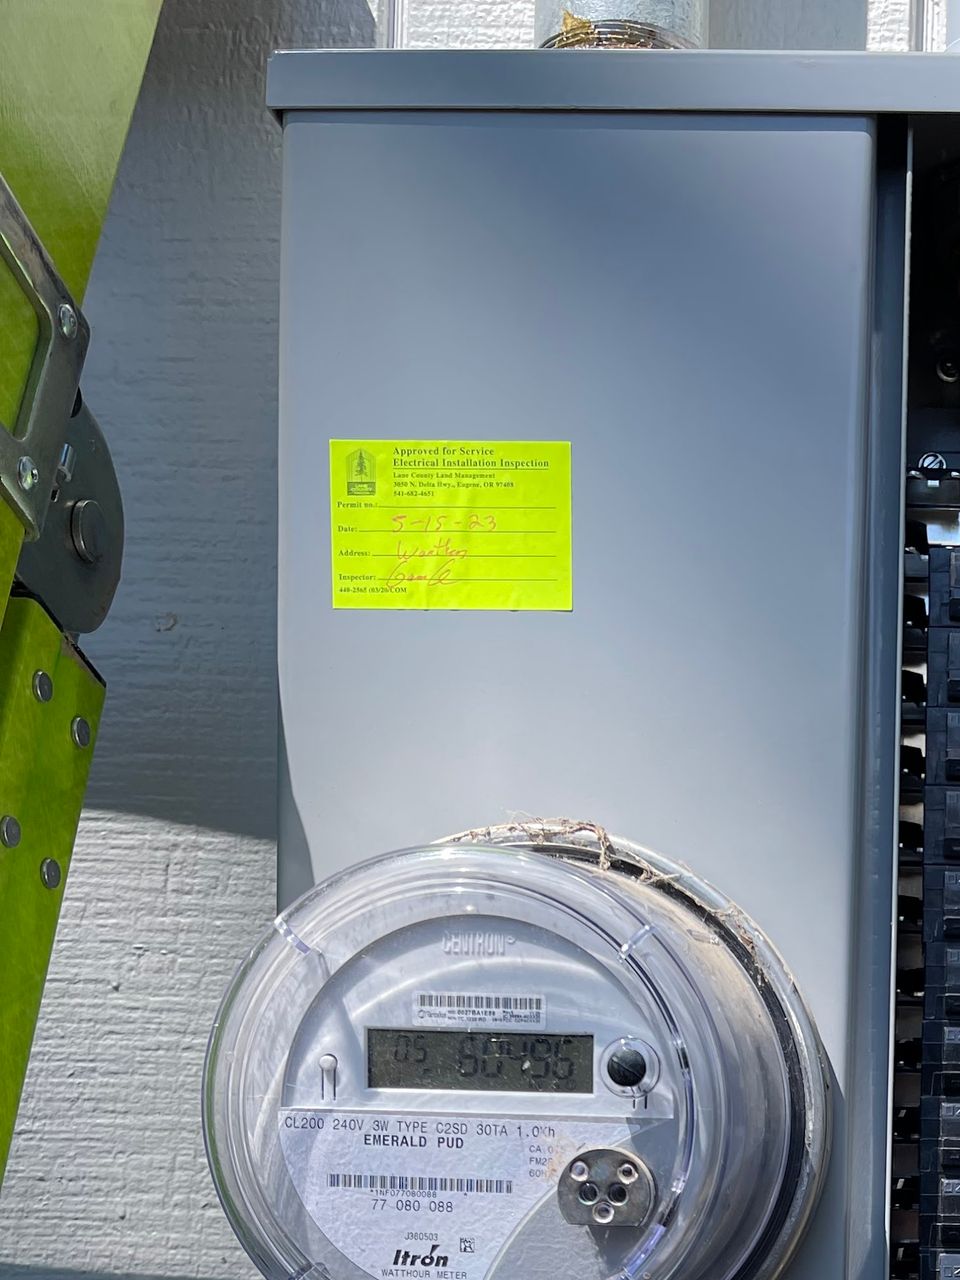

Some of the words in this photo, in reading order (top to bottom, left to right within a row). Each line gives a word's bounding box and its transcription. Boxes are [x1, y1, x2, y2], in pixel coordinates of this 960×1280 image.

[393, 447, 439, 457] Approved
[442, 447, 456, 456] for
[459, 447, 494, 456] Service
[393, 459, 439, 467] Electrical
[442, 459, 497, 467] Installation
[500, 459, 549, 469] Inspection
[339, 574, 376, 582] Inspector:
[285, 1117, 325, 1130] CL200
[333, 1119, 364, 1131] 240V
[373, 1120, 390, 1132] 3W
[397, 1121, 427, 1133] TYPE
[436, 1122, 468, 1134] C2SD
[476, 1124, 508, 1136] 30TA
[364, 1134, 427, 1148] EMERALD
[437, 1137, 464, 1149] PUD
[372, 1199, 386, 1210] 77
[396, 1200, 420, 1212] 080
[429, 1201, 453, 1212] 088
[381, 1269, 430, 1279] WATTHOUR
[437, 1271, 467, 1280] METER
